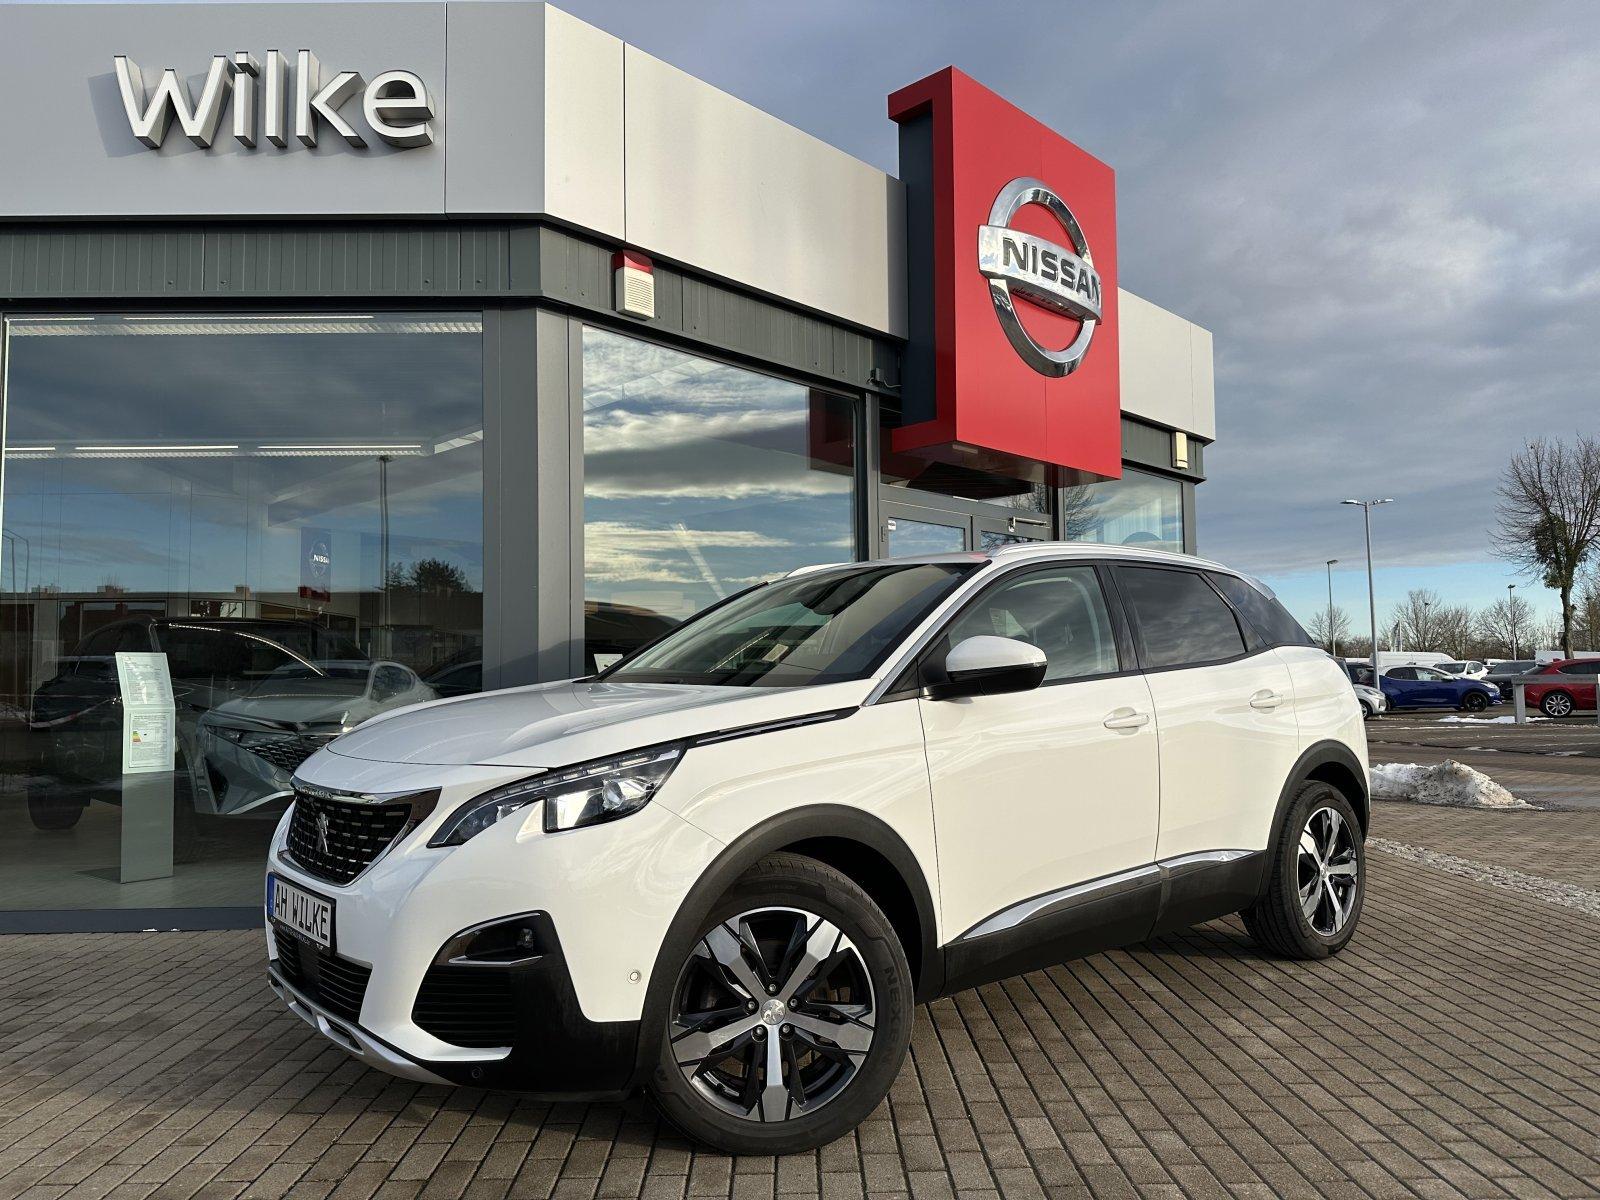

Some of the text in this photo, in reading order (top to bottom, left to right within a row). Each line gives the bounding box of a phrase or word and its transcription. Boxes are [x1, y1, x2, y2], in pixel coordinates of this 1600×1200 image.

[113, 49, 434, 148] Wilke
[1002, 237, 1101, 306] NISSAN
[275, 884, 288, 919] AH
[292, 893, 328, 941] WILKE
